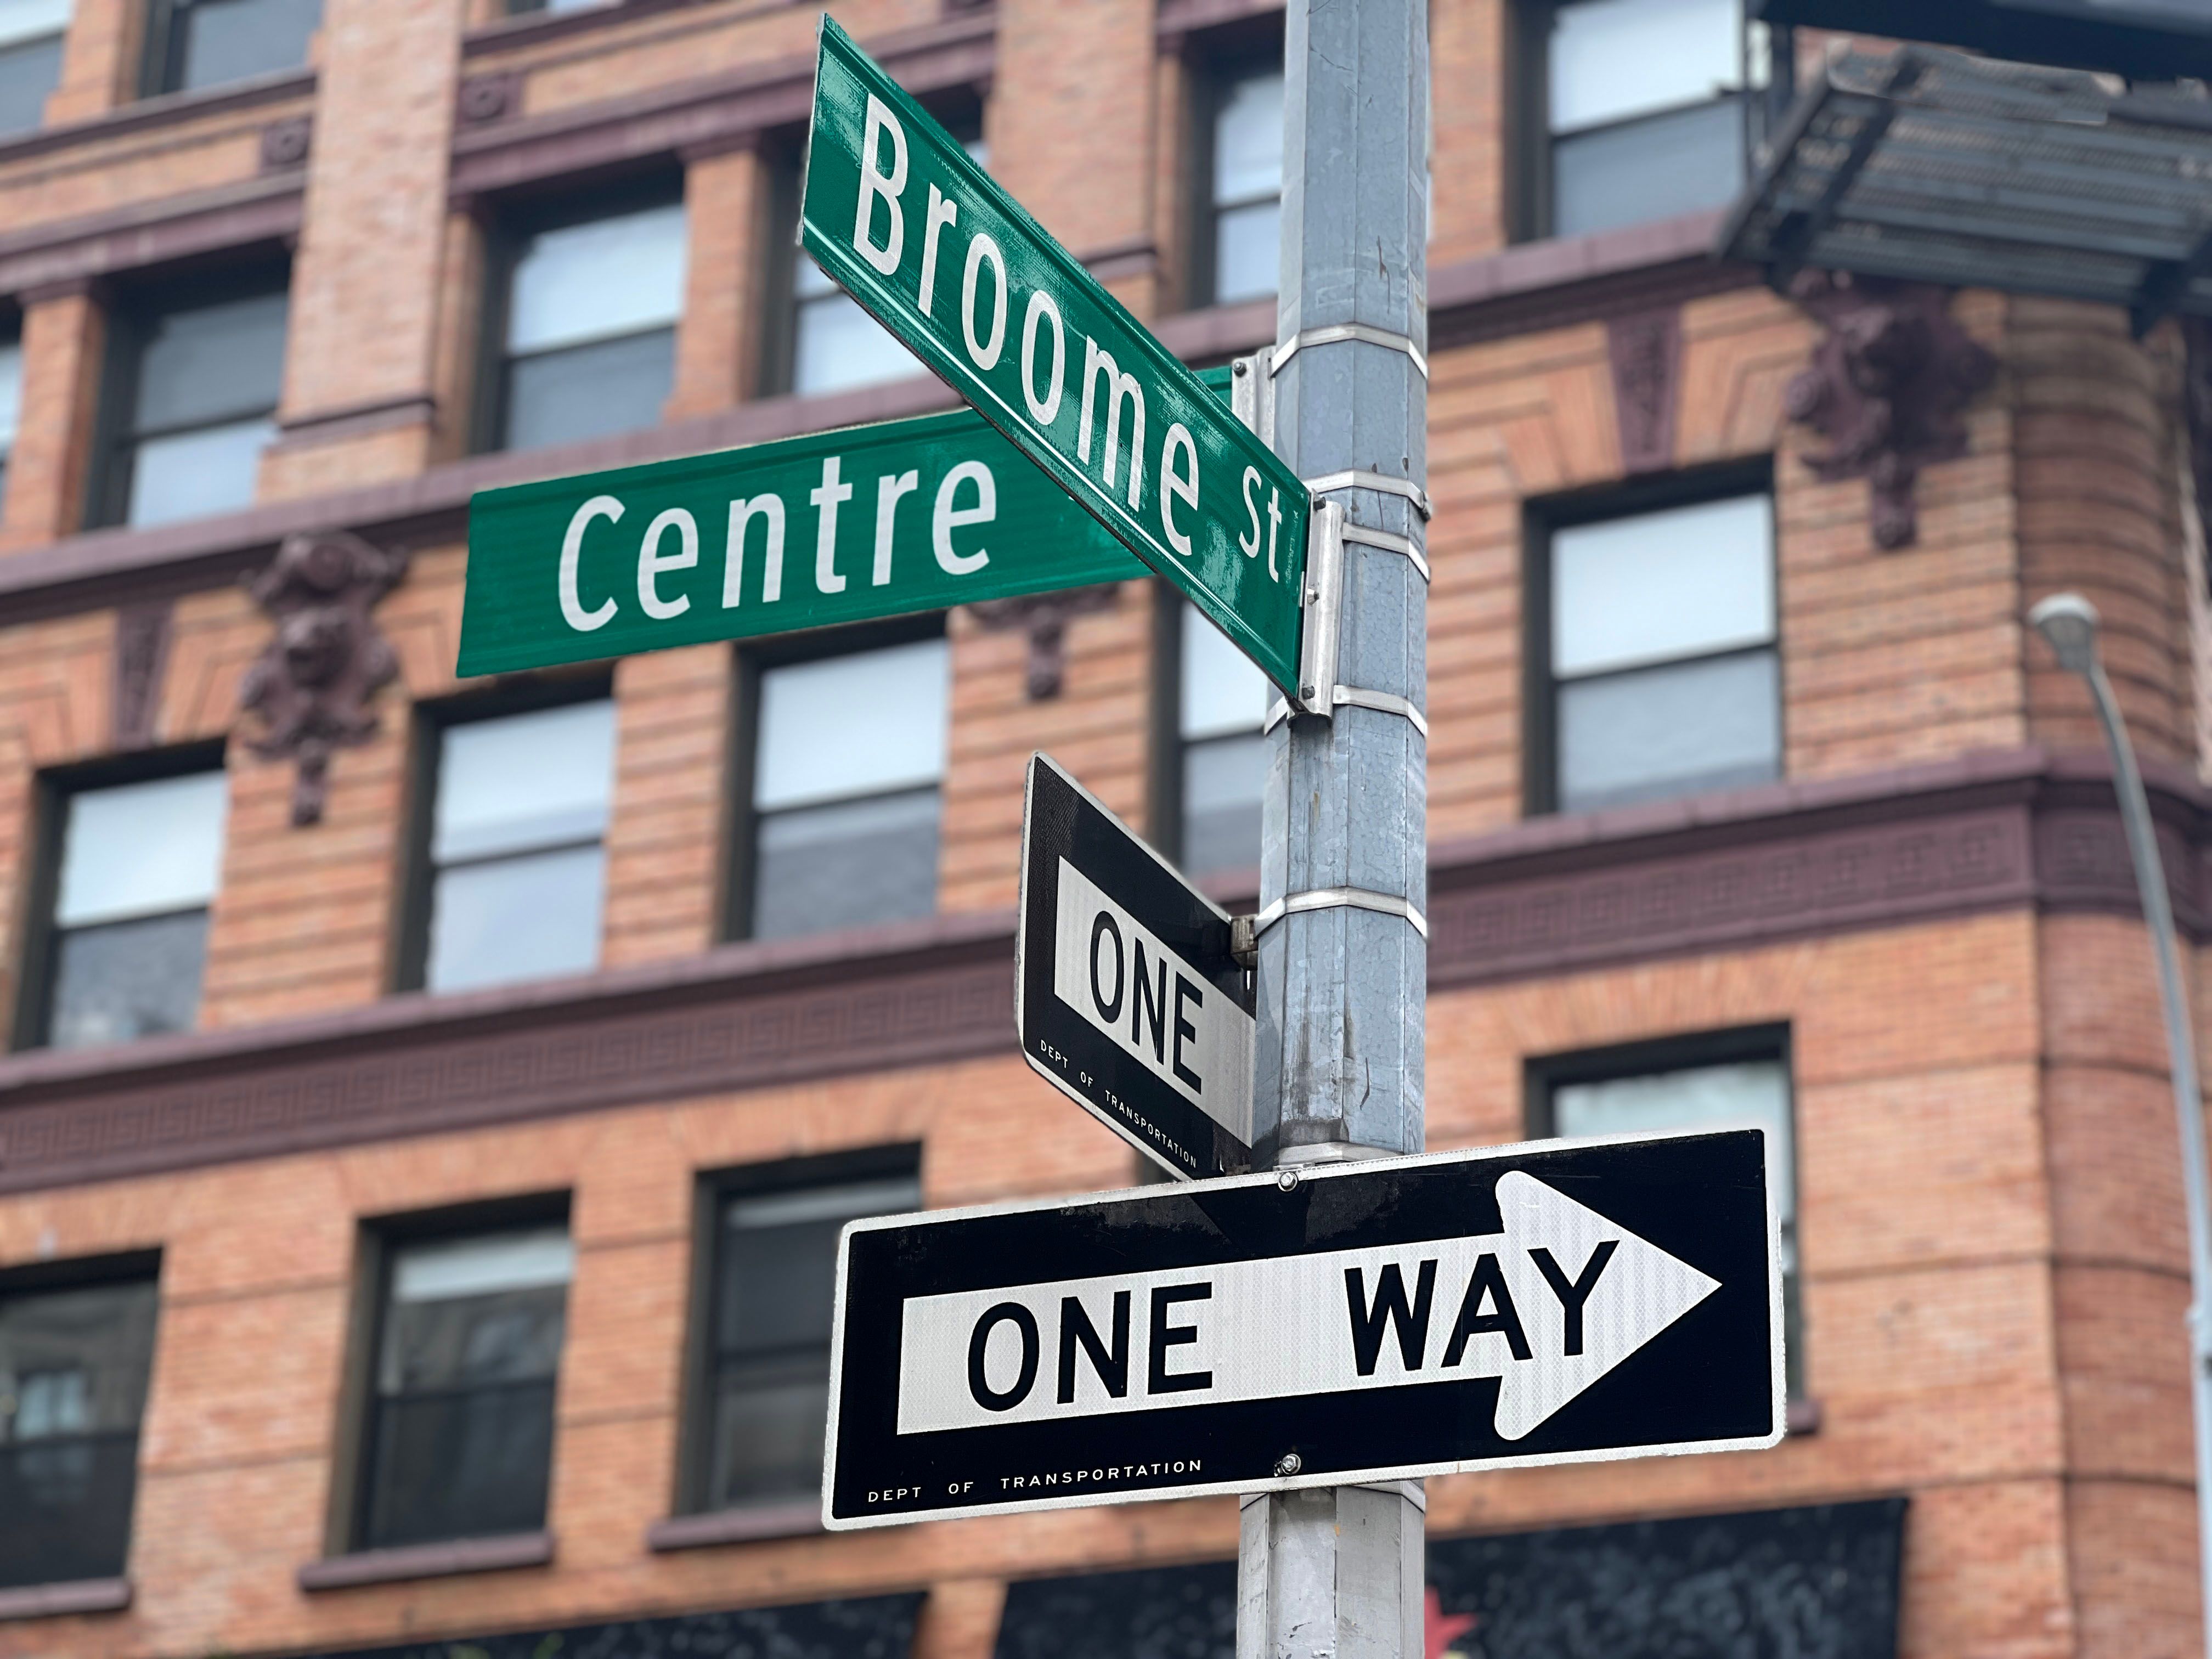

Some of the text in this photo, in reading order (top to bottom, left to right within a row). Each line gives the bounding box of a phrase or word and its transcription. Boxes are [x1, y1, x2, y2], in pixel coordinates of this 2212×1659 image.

[853, 93, 1283, 583] Broome St
[558, 456, 997, 632] Centre
[1090, 910, 1203, 1096] ONE
[1040, 1039, 1197, 1169] DEPT OF TRANSPORTATION
[968, 1239, 1621, 1413] ONE WAY
[867, 1459, 1203, 1503] DEPT OF TRANSPORTATION
